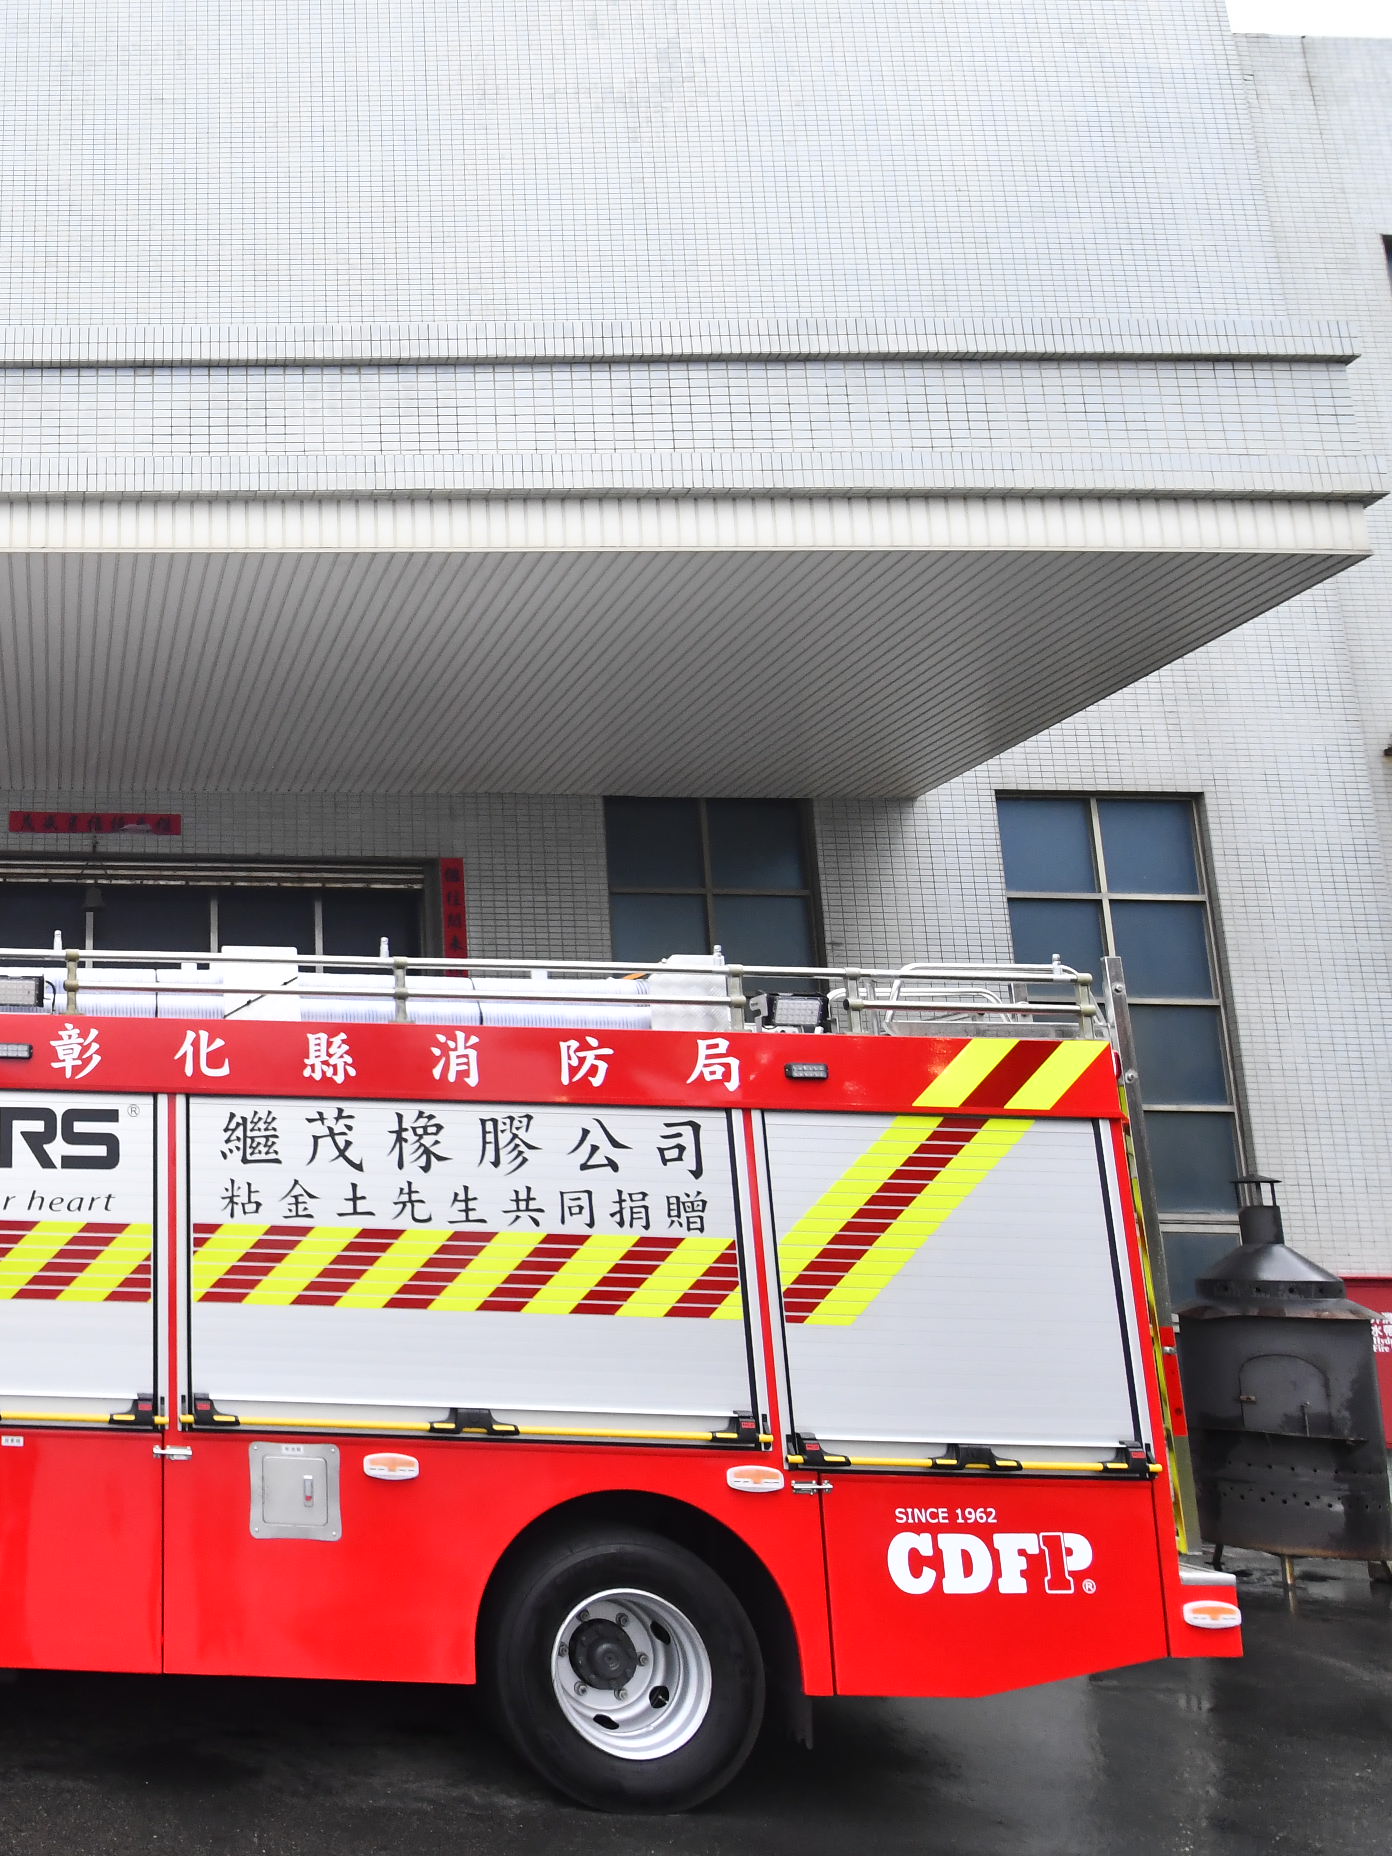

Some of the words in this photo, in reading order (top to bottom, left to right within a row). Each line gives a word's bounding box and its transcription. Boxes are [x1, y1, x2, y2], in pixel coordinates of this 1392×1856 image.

[50, 1023, 740, 1091] 彰化縣消防局
[221, 1107, 705, 1181] 繼茂橡膠公司
[27, 1189, 117, 1213] heart
[221, 1178, 709, 1234] 粘金土先生共同捐贈
[894, 1507, 949, 1524] SINCE
[955, 1507, 998, 1524] 1962
